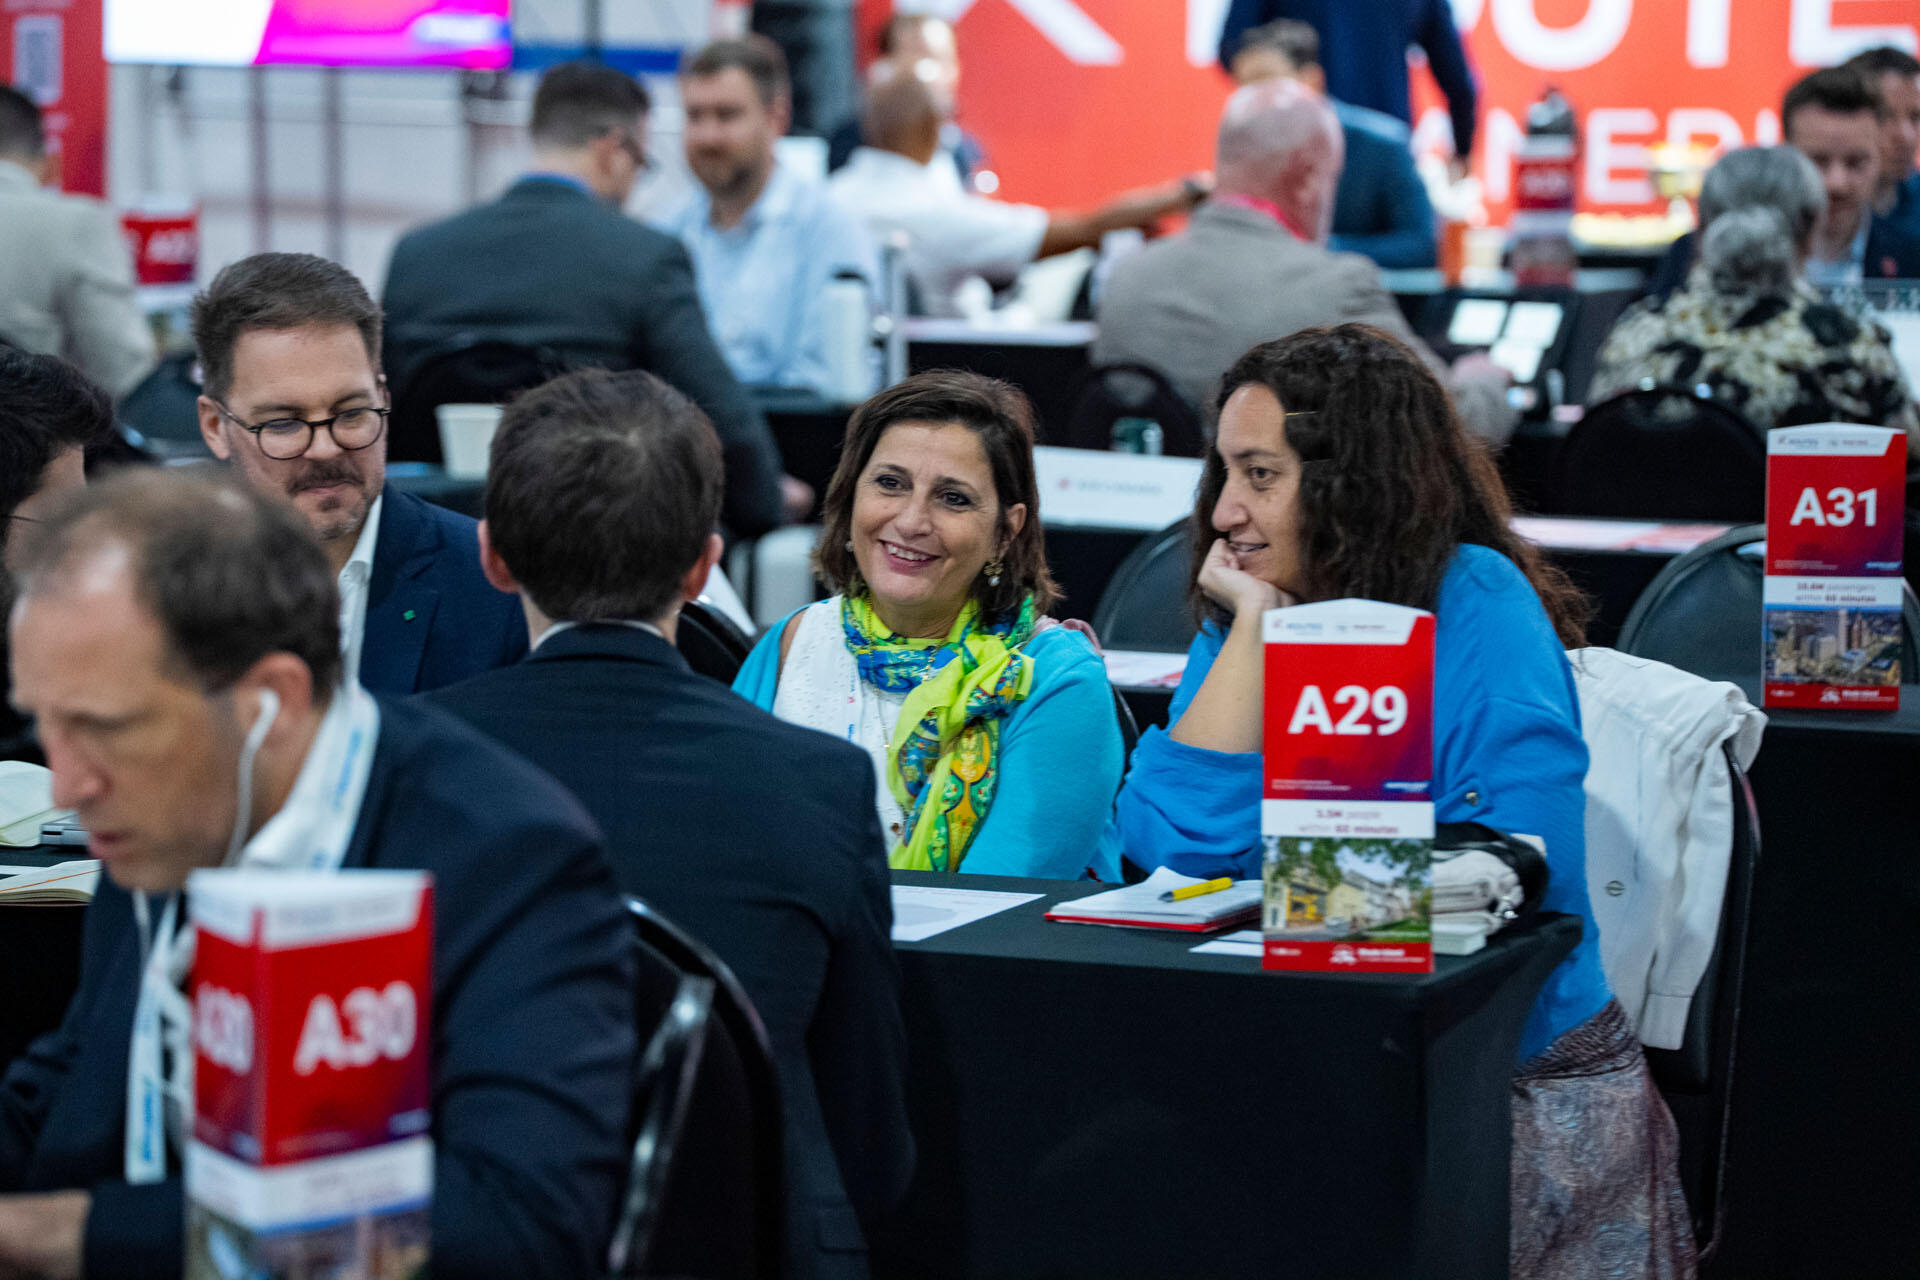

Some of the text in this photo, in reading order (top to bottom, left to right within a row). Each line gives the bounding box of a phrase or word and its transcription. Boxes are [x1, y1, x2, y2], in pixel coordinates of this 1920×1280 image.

[1790, 487, 1877, 527] A31
[1287, 685, 1408, 736] A29
[293, 980, 418, 1076] A30
